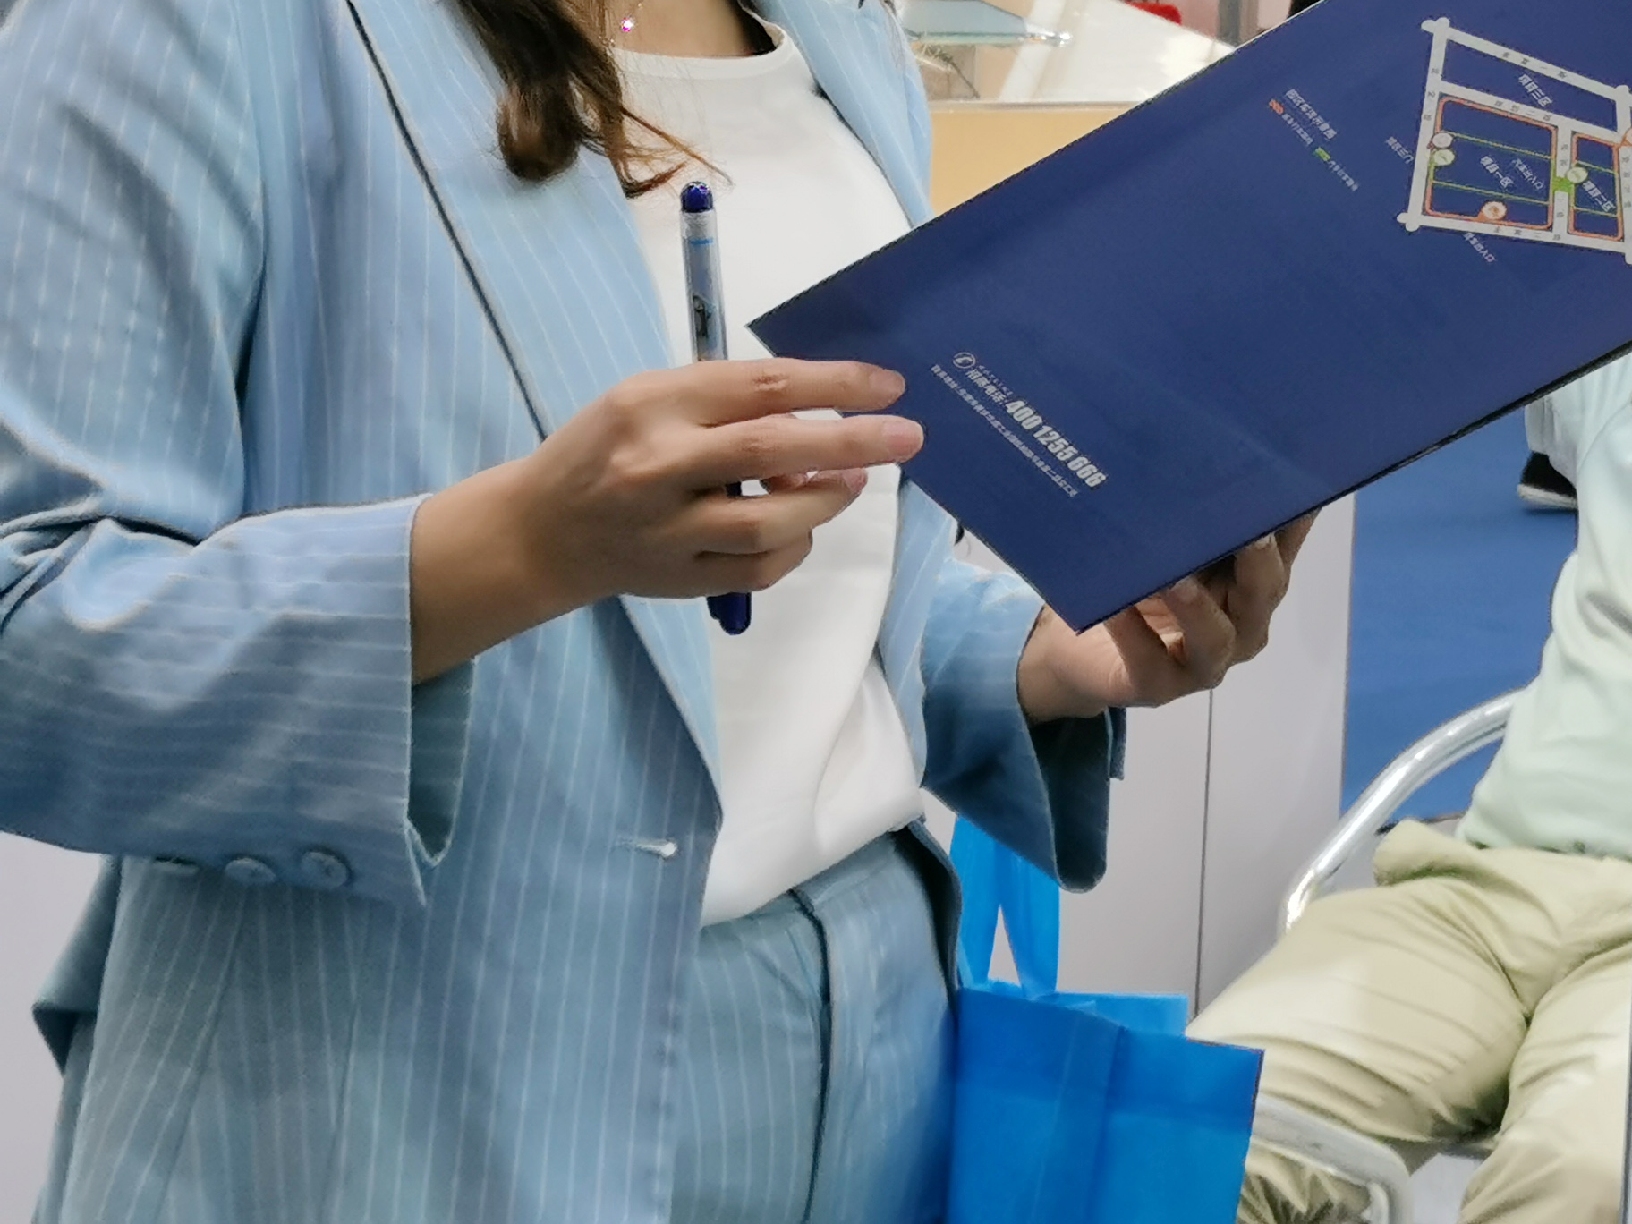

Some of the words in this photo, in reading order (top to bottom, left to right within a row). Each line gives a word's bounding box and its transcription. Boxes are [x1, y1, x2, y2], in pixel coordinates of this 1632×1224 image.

[1006, 399, 1043, 431] 400
[1032, 424, 1080, 463] 1255
[1066, 456, 1108, 489] 666
